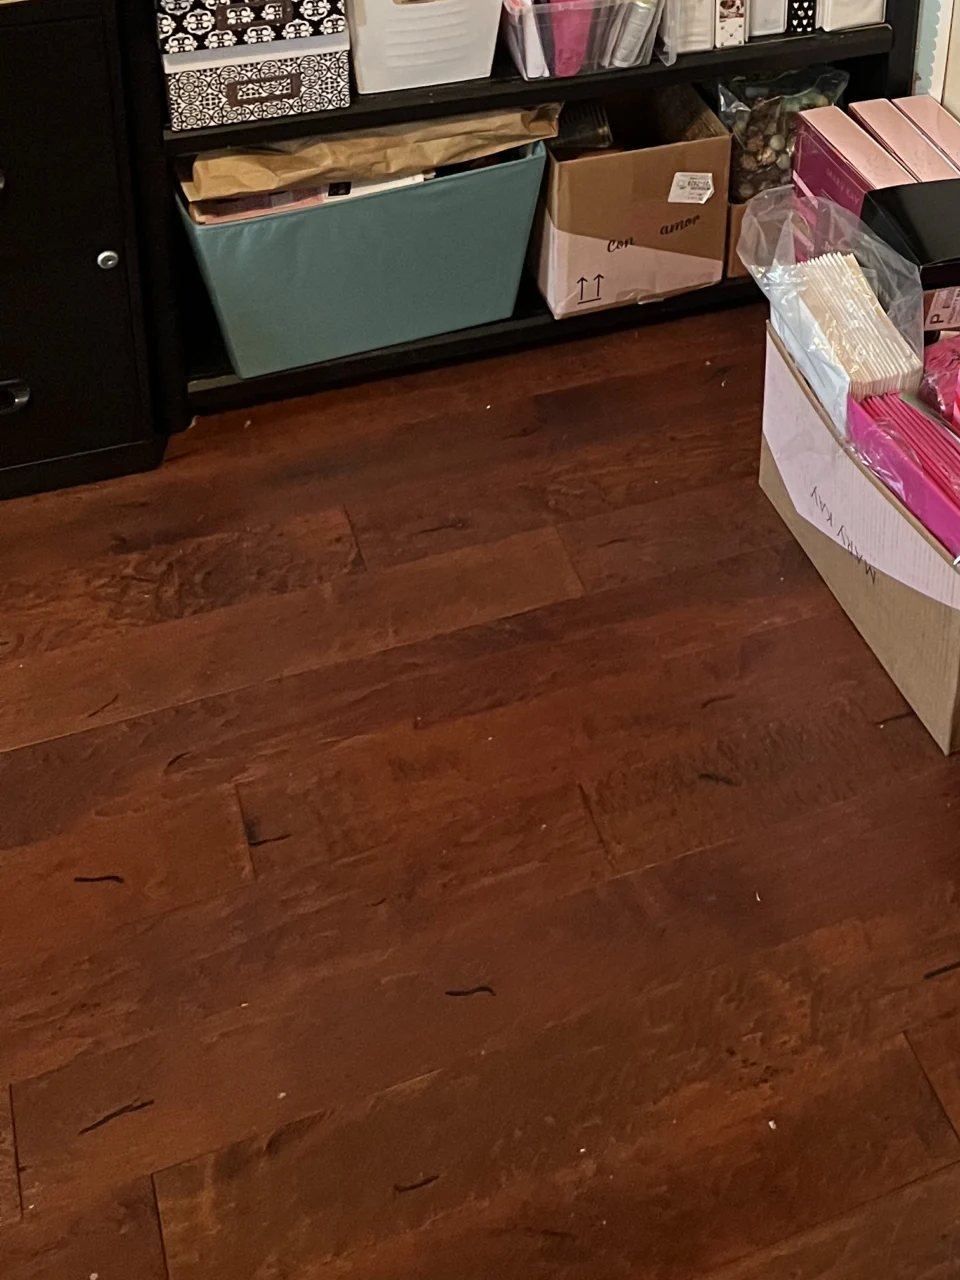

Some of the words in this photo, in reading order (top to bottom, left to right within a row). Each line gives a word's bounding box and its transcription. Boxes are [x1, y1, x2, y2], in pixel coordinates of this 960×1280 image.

[607, 236, 634, 253] Con
[659, 214, 700, 236] amor
[811, 485, 833, 527] KAY
[837, 524, 877, 585] MARY
